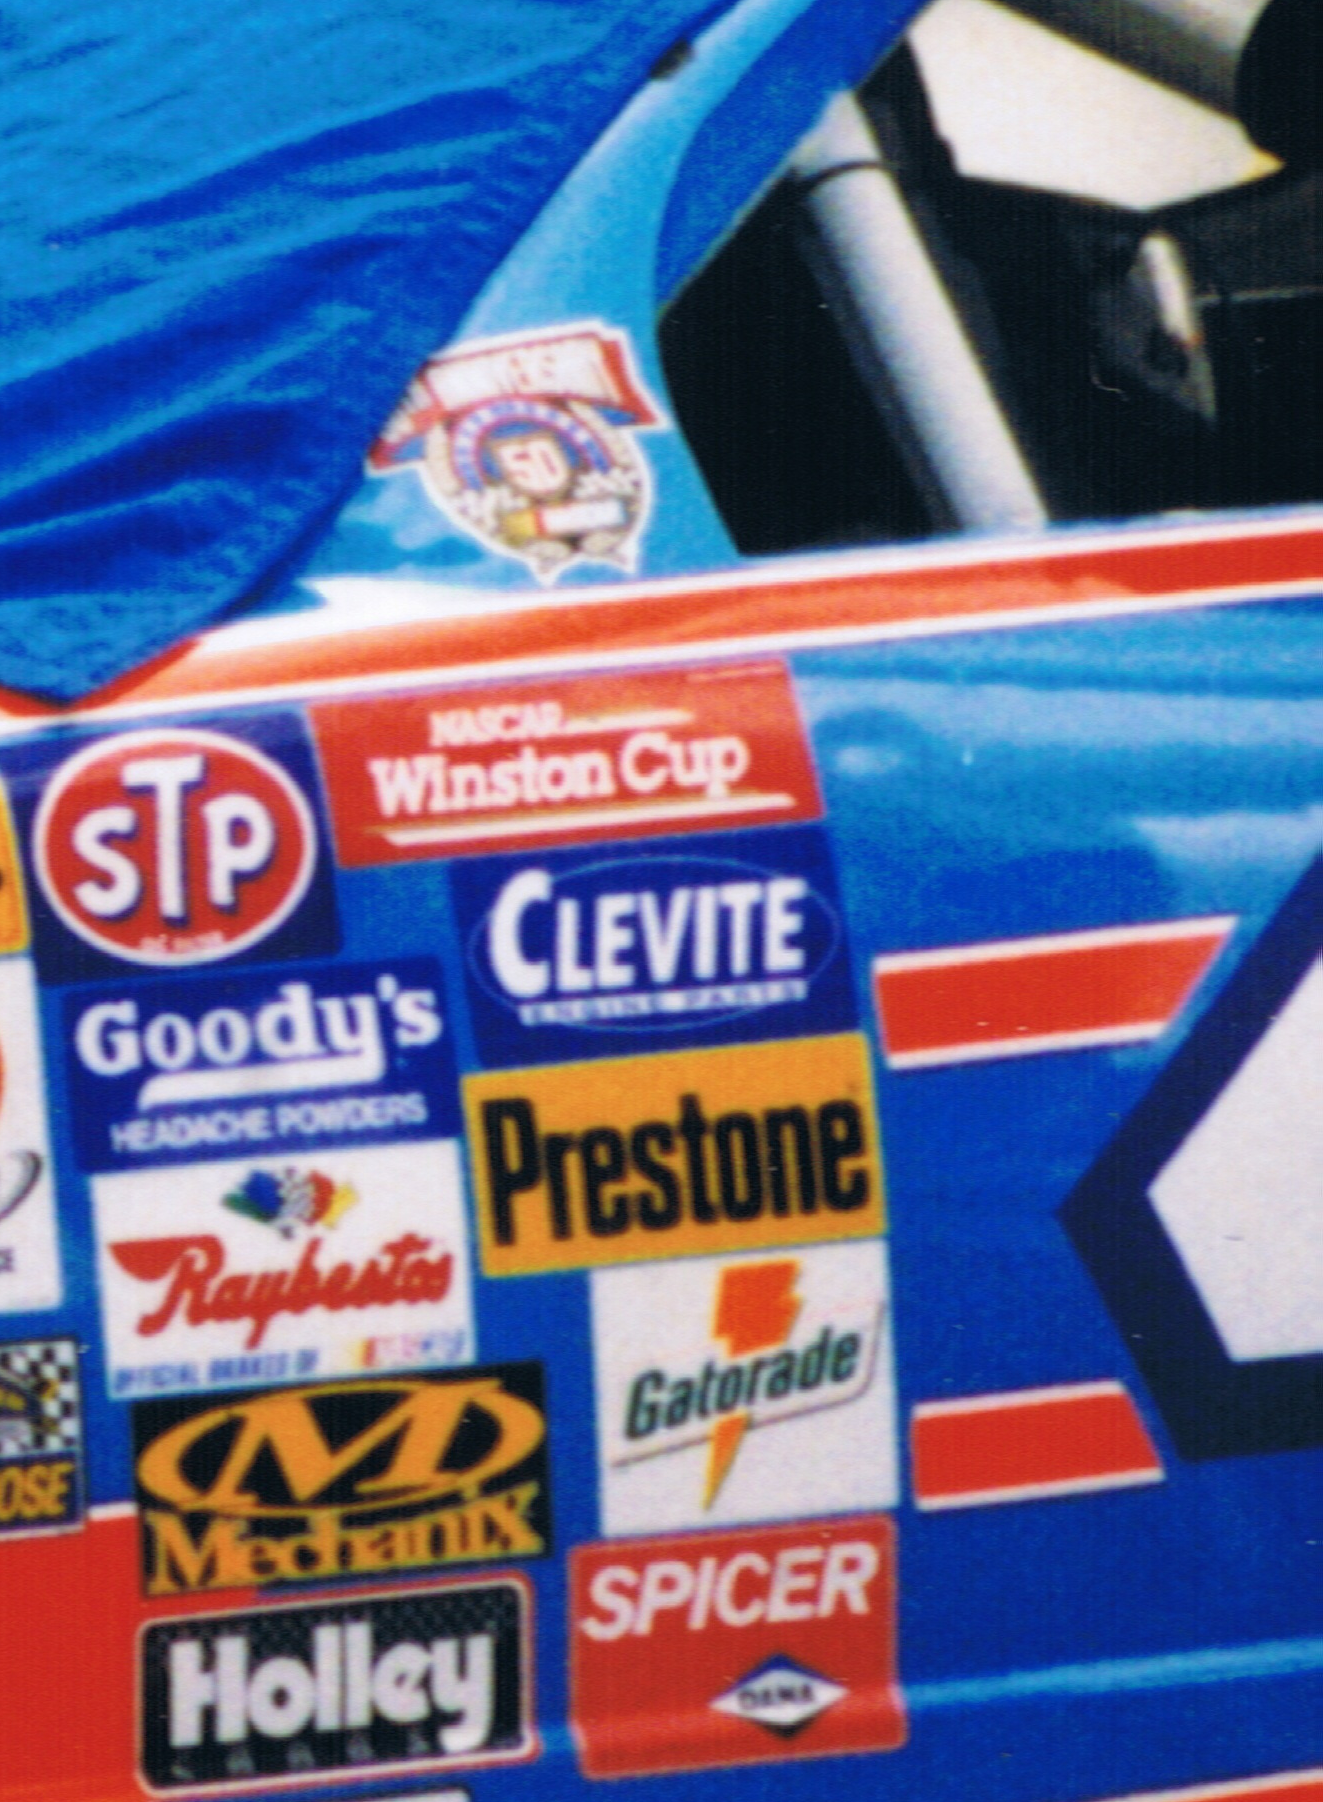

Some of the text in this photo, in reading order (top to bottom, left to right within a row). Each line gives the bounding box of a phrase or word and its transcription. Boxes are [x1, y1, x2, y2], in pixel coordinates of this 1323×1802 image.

[367, 731, 751, 819] Winston Cup
[428, 701, 568, 748] NASCAR
[70, 753, 280, 924] STP
[488, 869, 812, 998] CLEVITE
[74, 973, 443, 1092] Goody's
[110, 1091, 428, 1153] HEADACHE POWDERS
[481, 1091, 871, 1247] Prestone
[108, 1232, 453, 1350] Raybestos
[624, 1324, 862, 1441] Gatorade
[145, 1482, 546, 1595] Mechanix
[579, 1539, 881, 1642] SPICER
[168, 1619, 495, 1755] Holley
